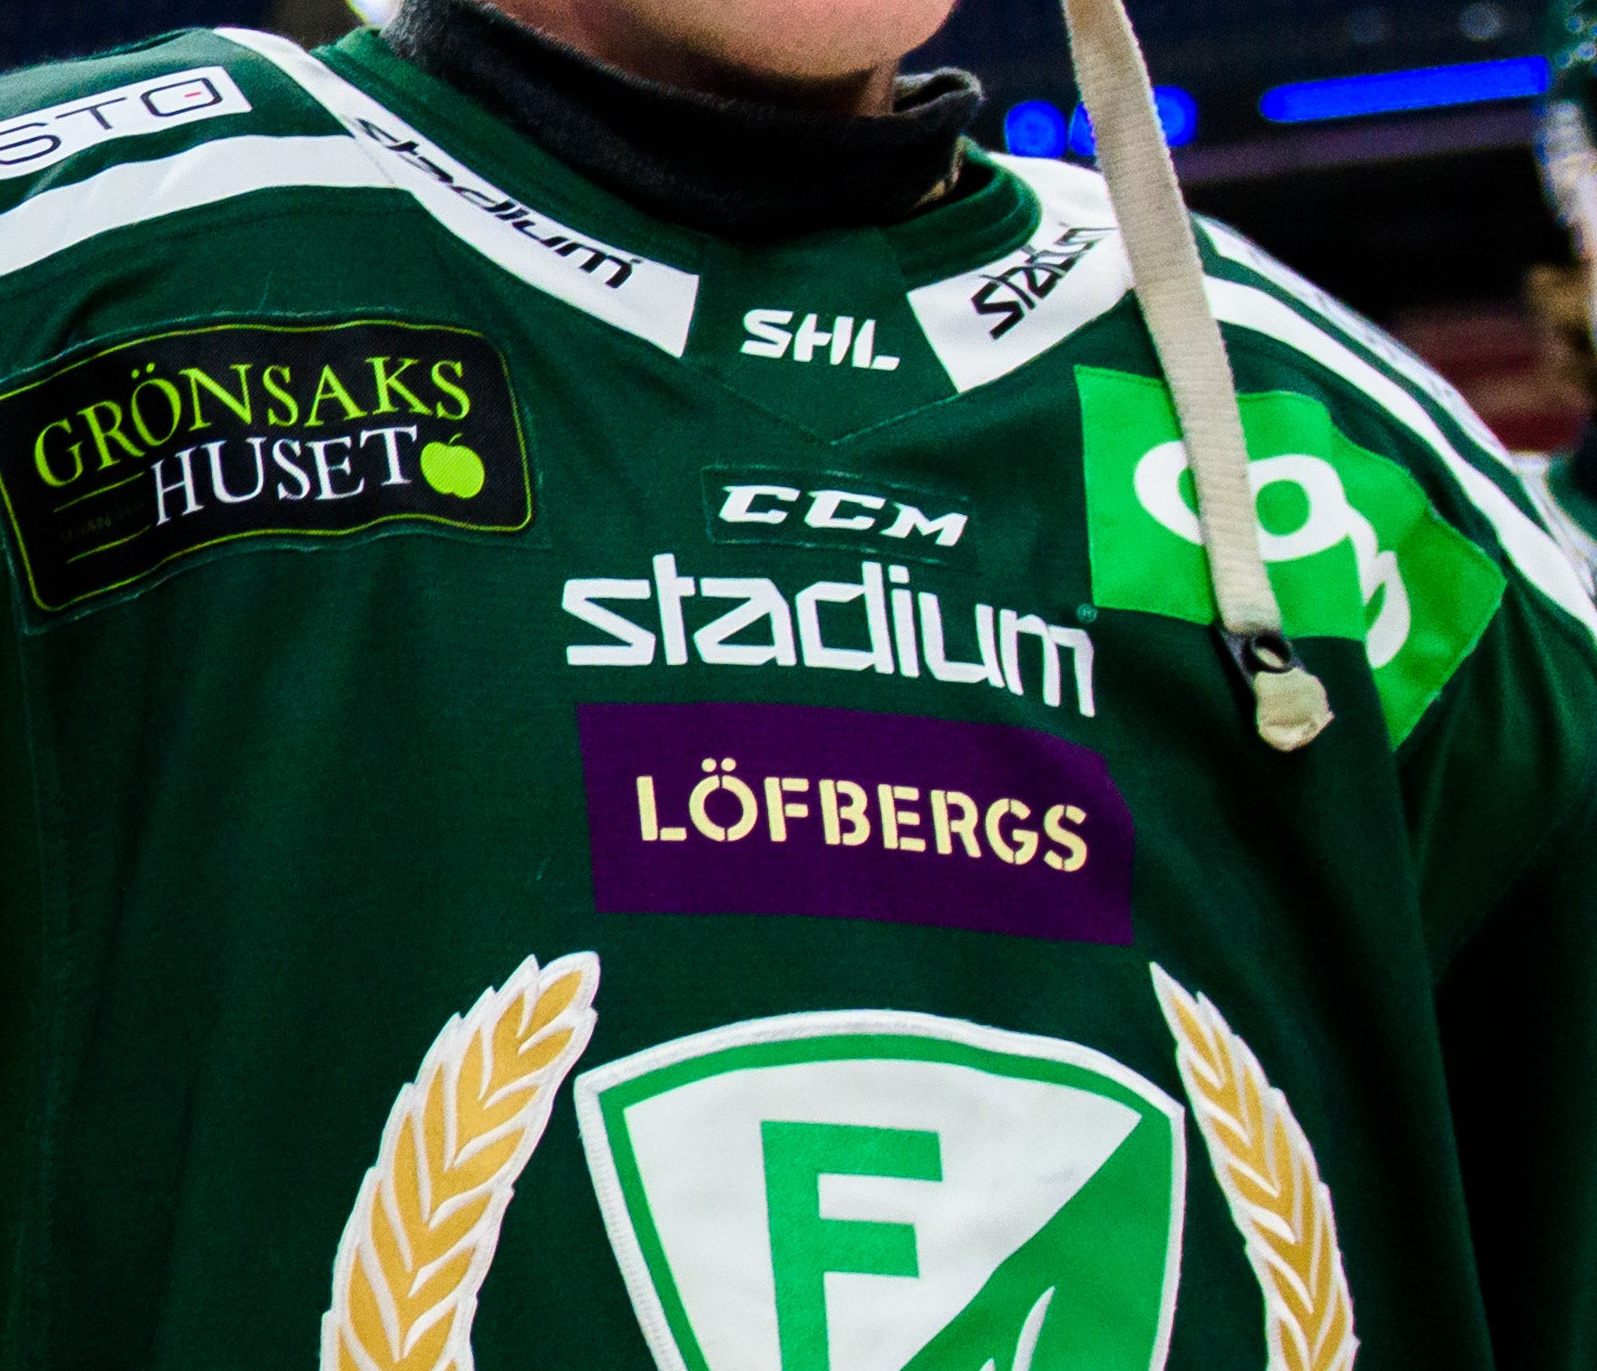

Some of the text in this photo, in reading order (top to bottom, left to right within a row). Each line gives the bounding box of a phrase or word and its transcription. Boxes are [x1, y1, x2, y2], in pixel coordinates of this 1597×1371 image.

[354, 114, 642, 291] stadium
[740, 307, 901, 371] SHL
[32, 357, 472, 488] GRÖNSAKS
[151, 426, 418, 527] HUSET
[718, 484, 969, 546] CCM
[561, 551, 1095, 717] stadium
[635, 756, 1091, 872] LÖFBERGS
